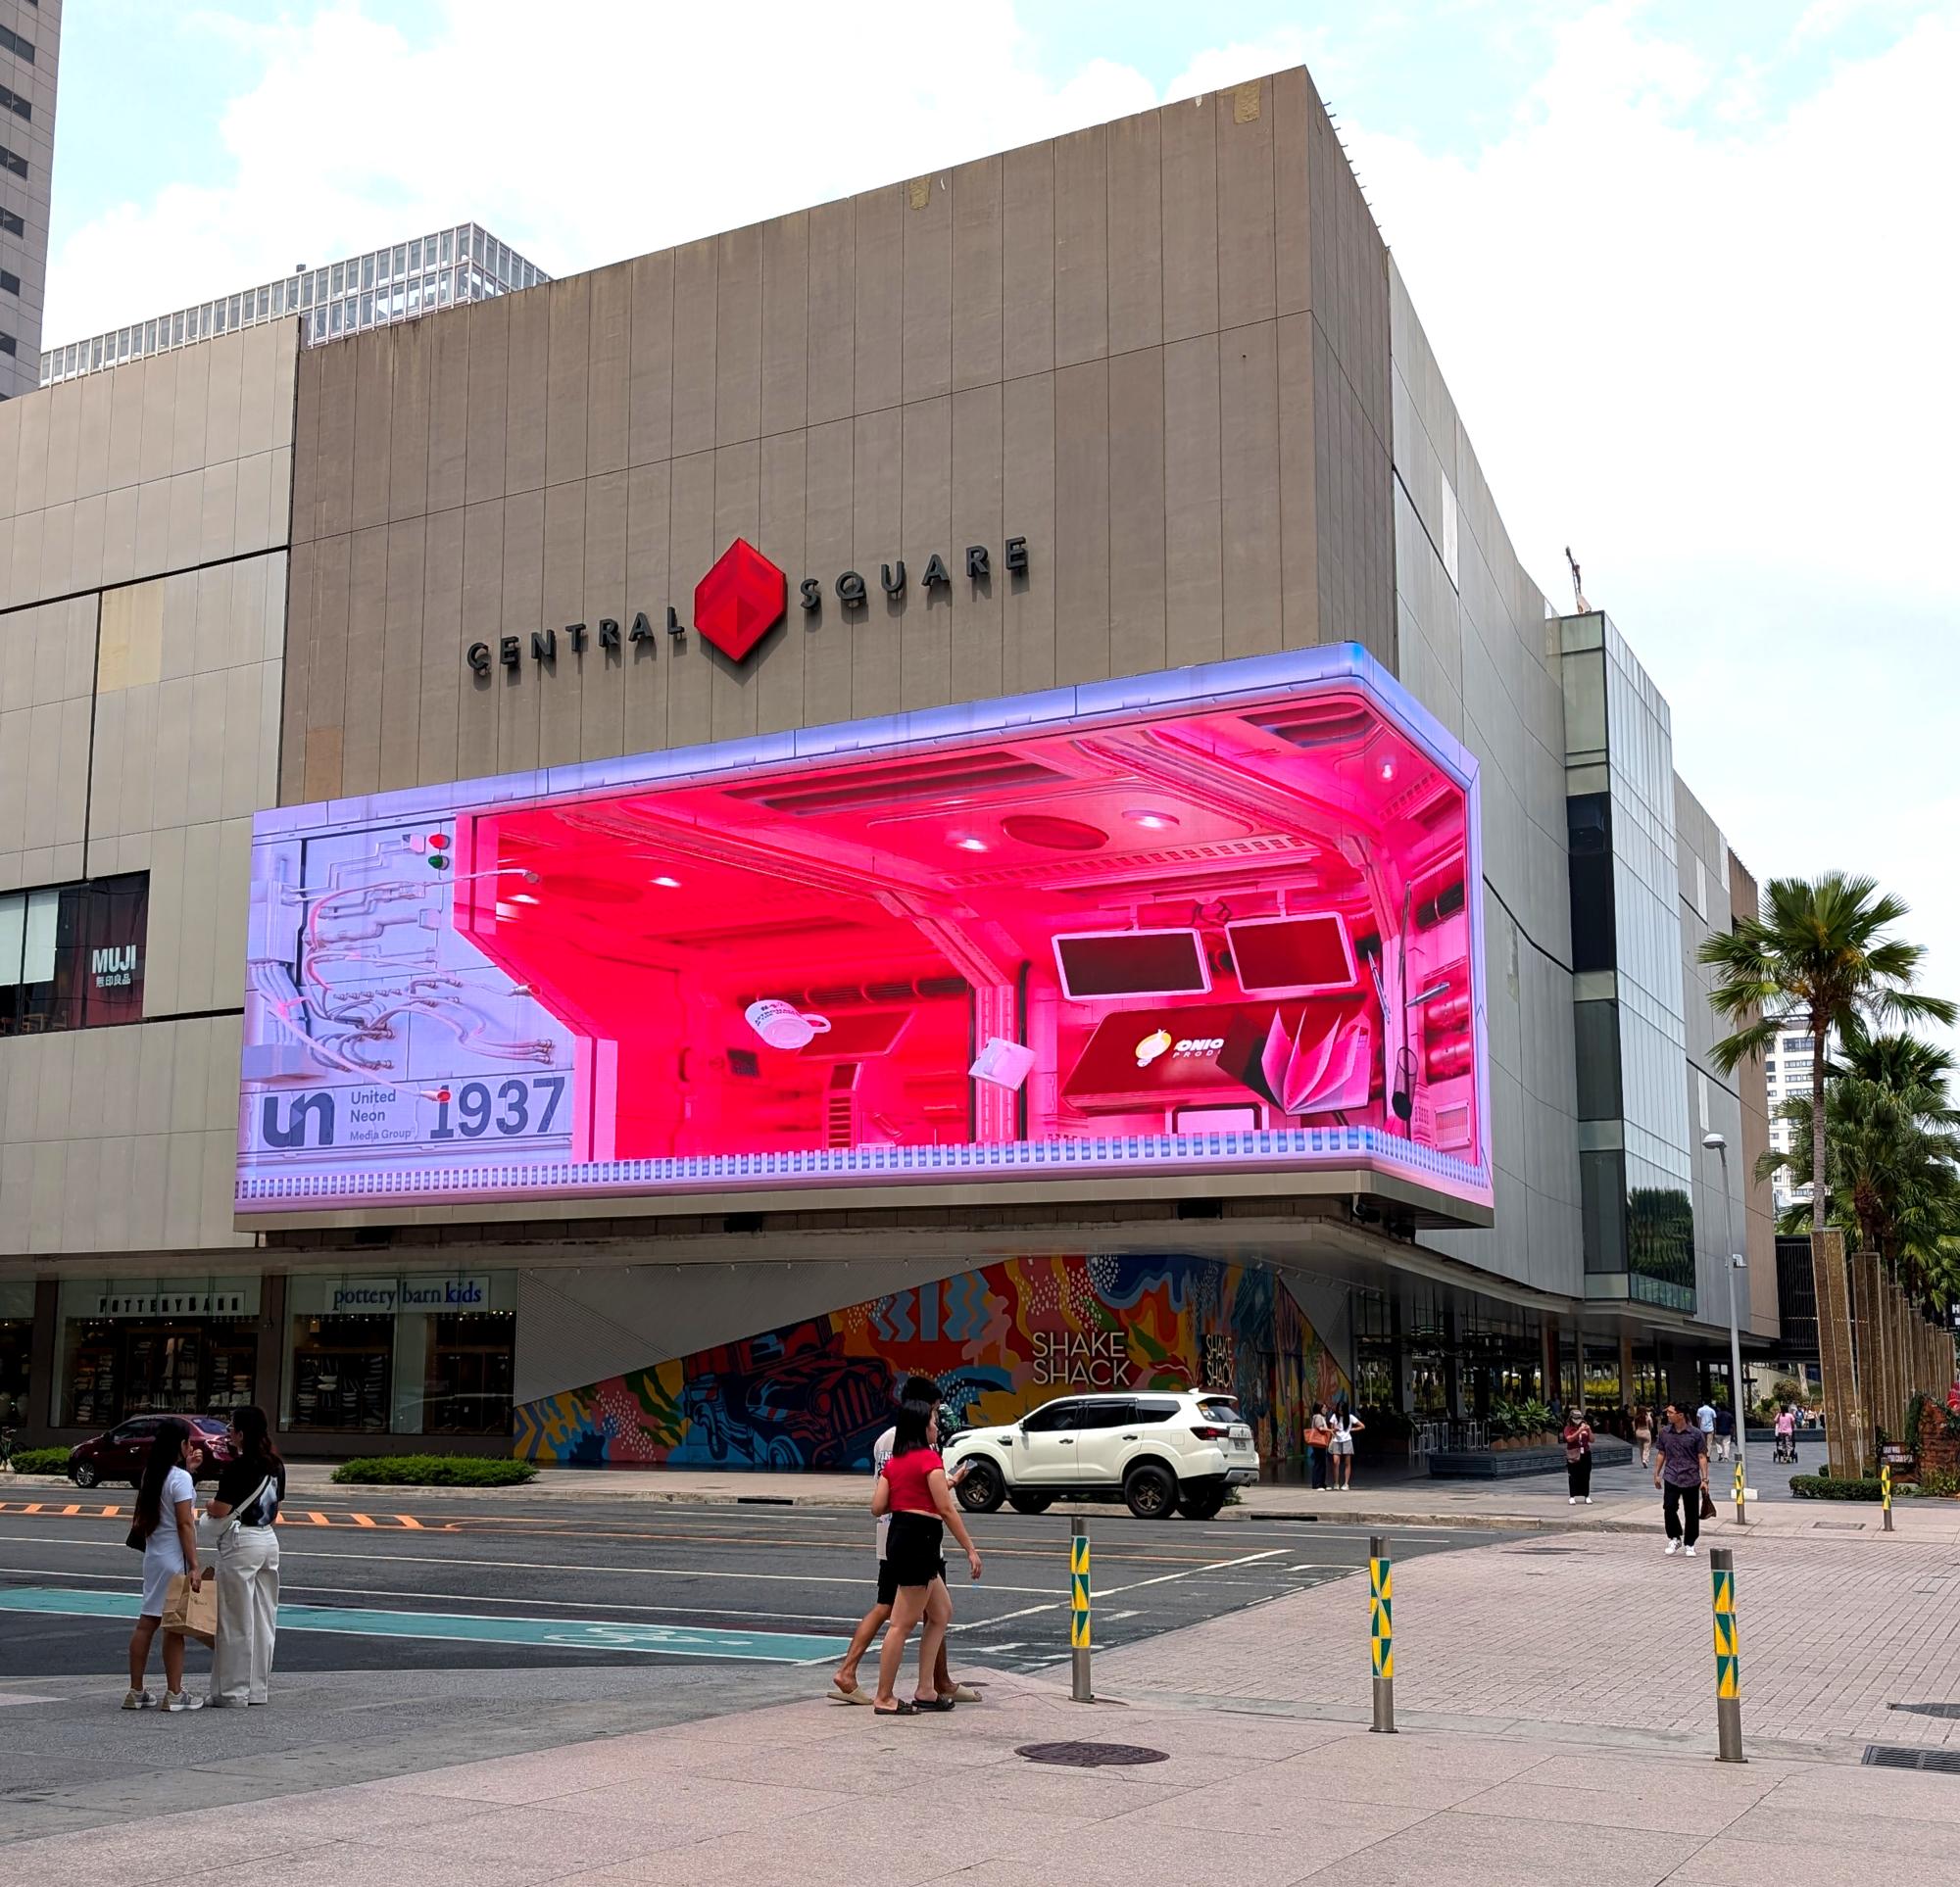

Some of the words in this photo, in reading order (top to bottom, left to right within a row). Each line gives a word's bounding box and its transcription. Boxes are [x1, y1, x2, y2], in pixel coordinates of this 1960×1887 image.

[467, 605, 684, 670] CENTRAL
[800, 537, 1028, 609] SQUARE
[92, 944, 136, 974] MUJI
[351, 1089, 396, 1105] United
[429, 1076, 565, 1139] 1937
[350, 1109, 386, 1123] Neon
[350, 1129, 379, 1141] Media
[381, 1129, 412, 1140] Group
[332, 1289, 396, 1311] pottery
[402, 1281, 441, 1304] barn
[444, 1281, 482, 1304] kids
[1032, 1331, 1126, 1358] SHAKE
[1205, 1333, 1233, 1360] SHAKE
[1032, 1359, 1130, 1385] SHACK
[1205, 1360, 1235, 1388] SHACK
